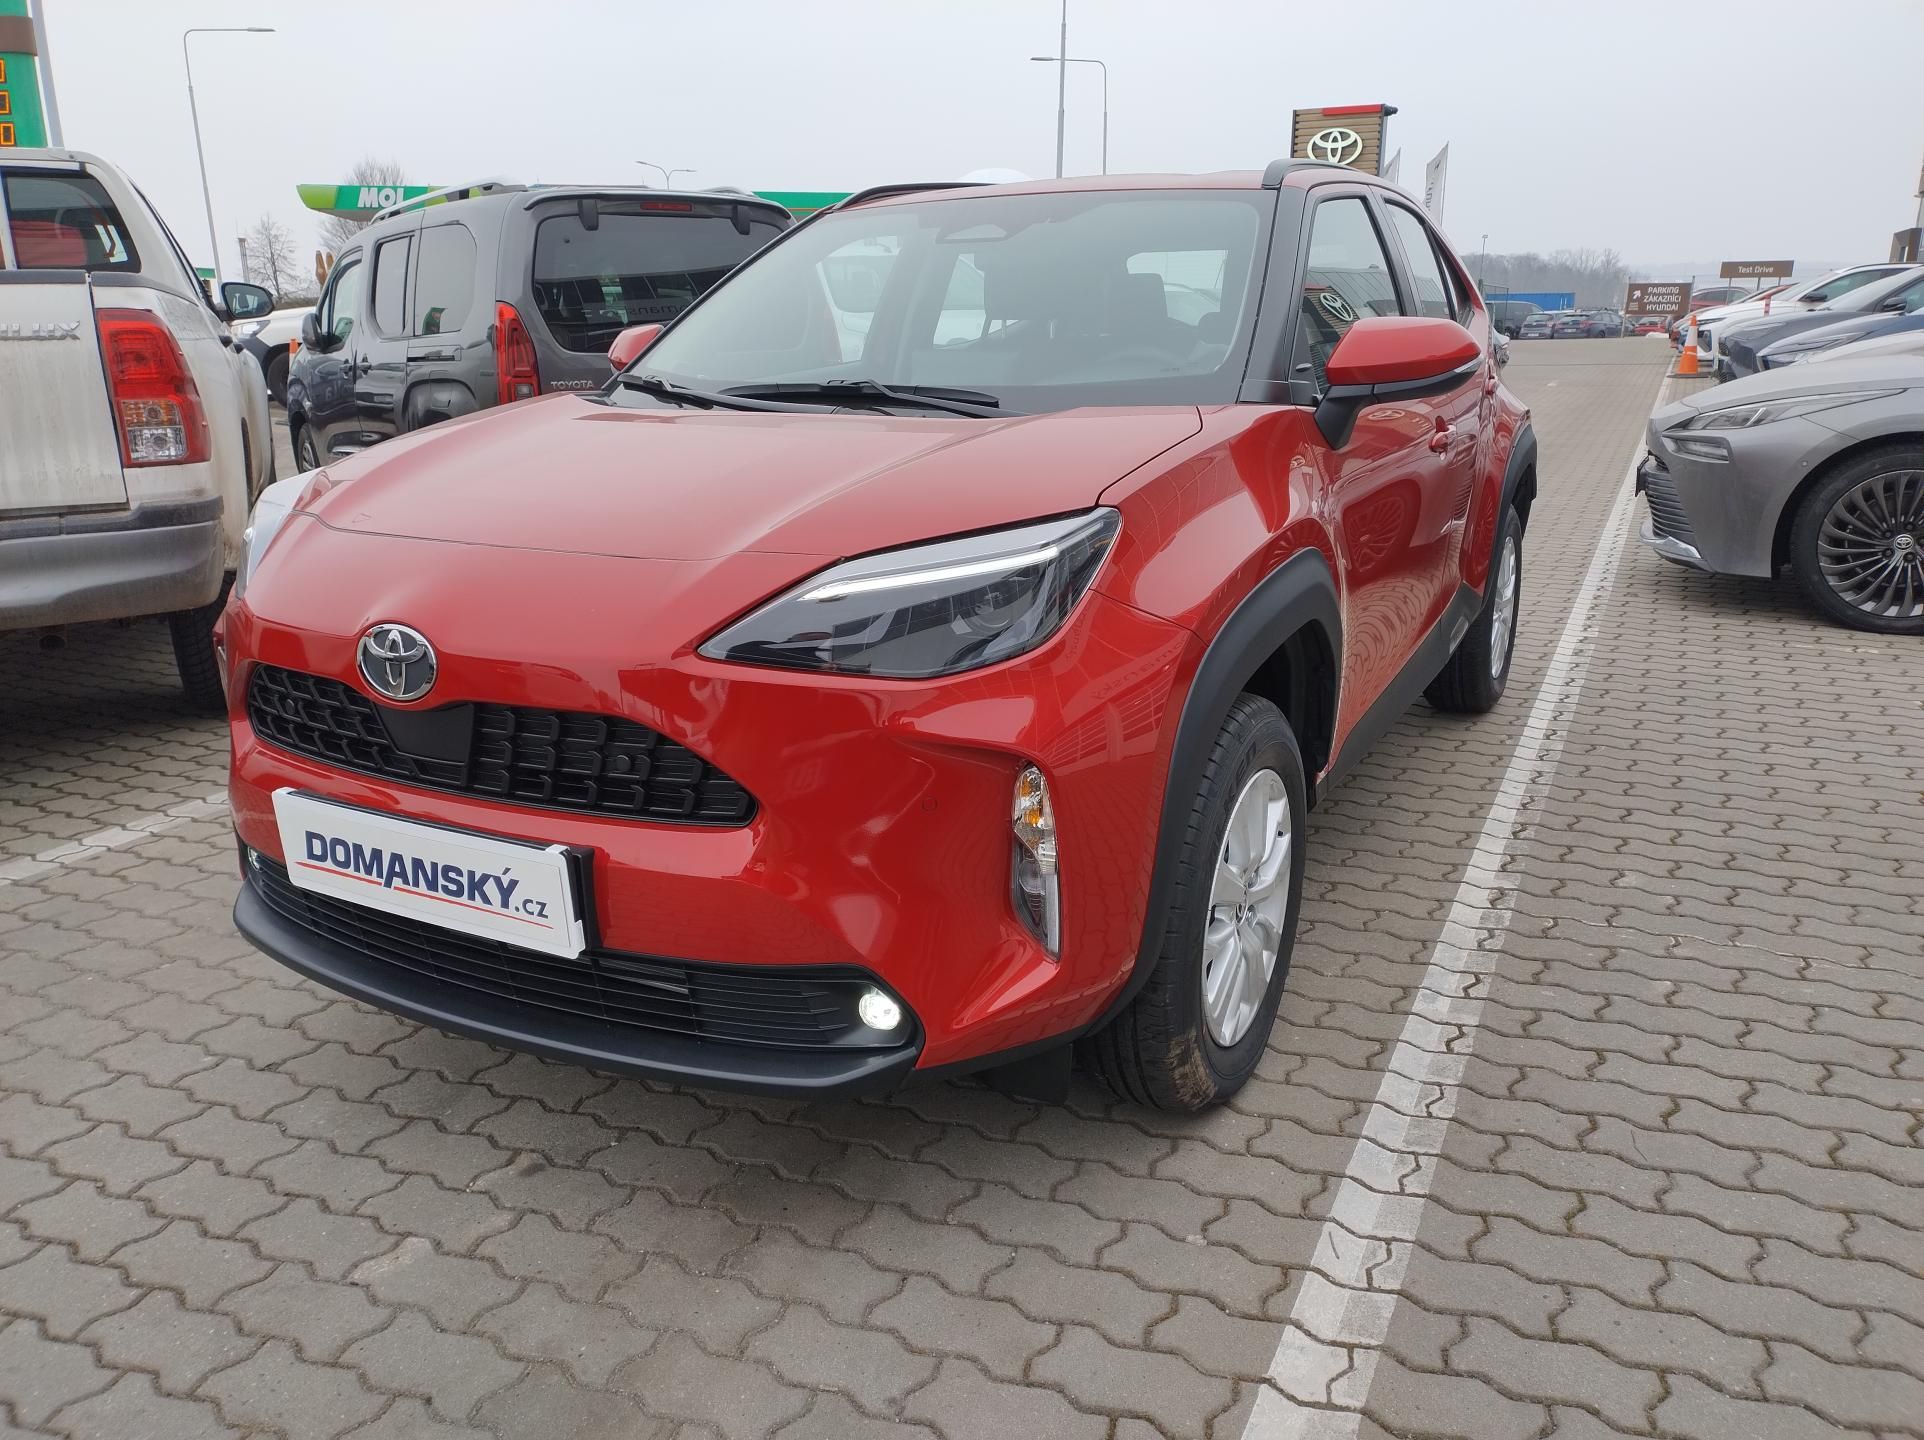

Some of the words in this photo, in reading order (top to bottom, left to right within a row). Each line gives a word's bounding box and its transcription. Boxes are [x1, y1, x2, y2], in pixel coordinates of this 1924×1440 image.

[1738, 265, 1753, 274] Test
[1754, 265, 1774, 273] Drive
[1647, 286, 1680, 295] PARKING
[1646, 303, 1679, 312] HYUNDAI
[0, 320, 81, 341] ILUX
[550, 380, 594, 390] TOYOTA
